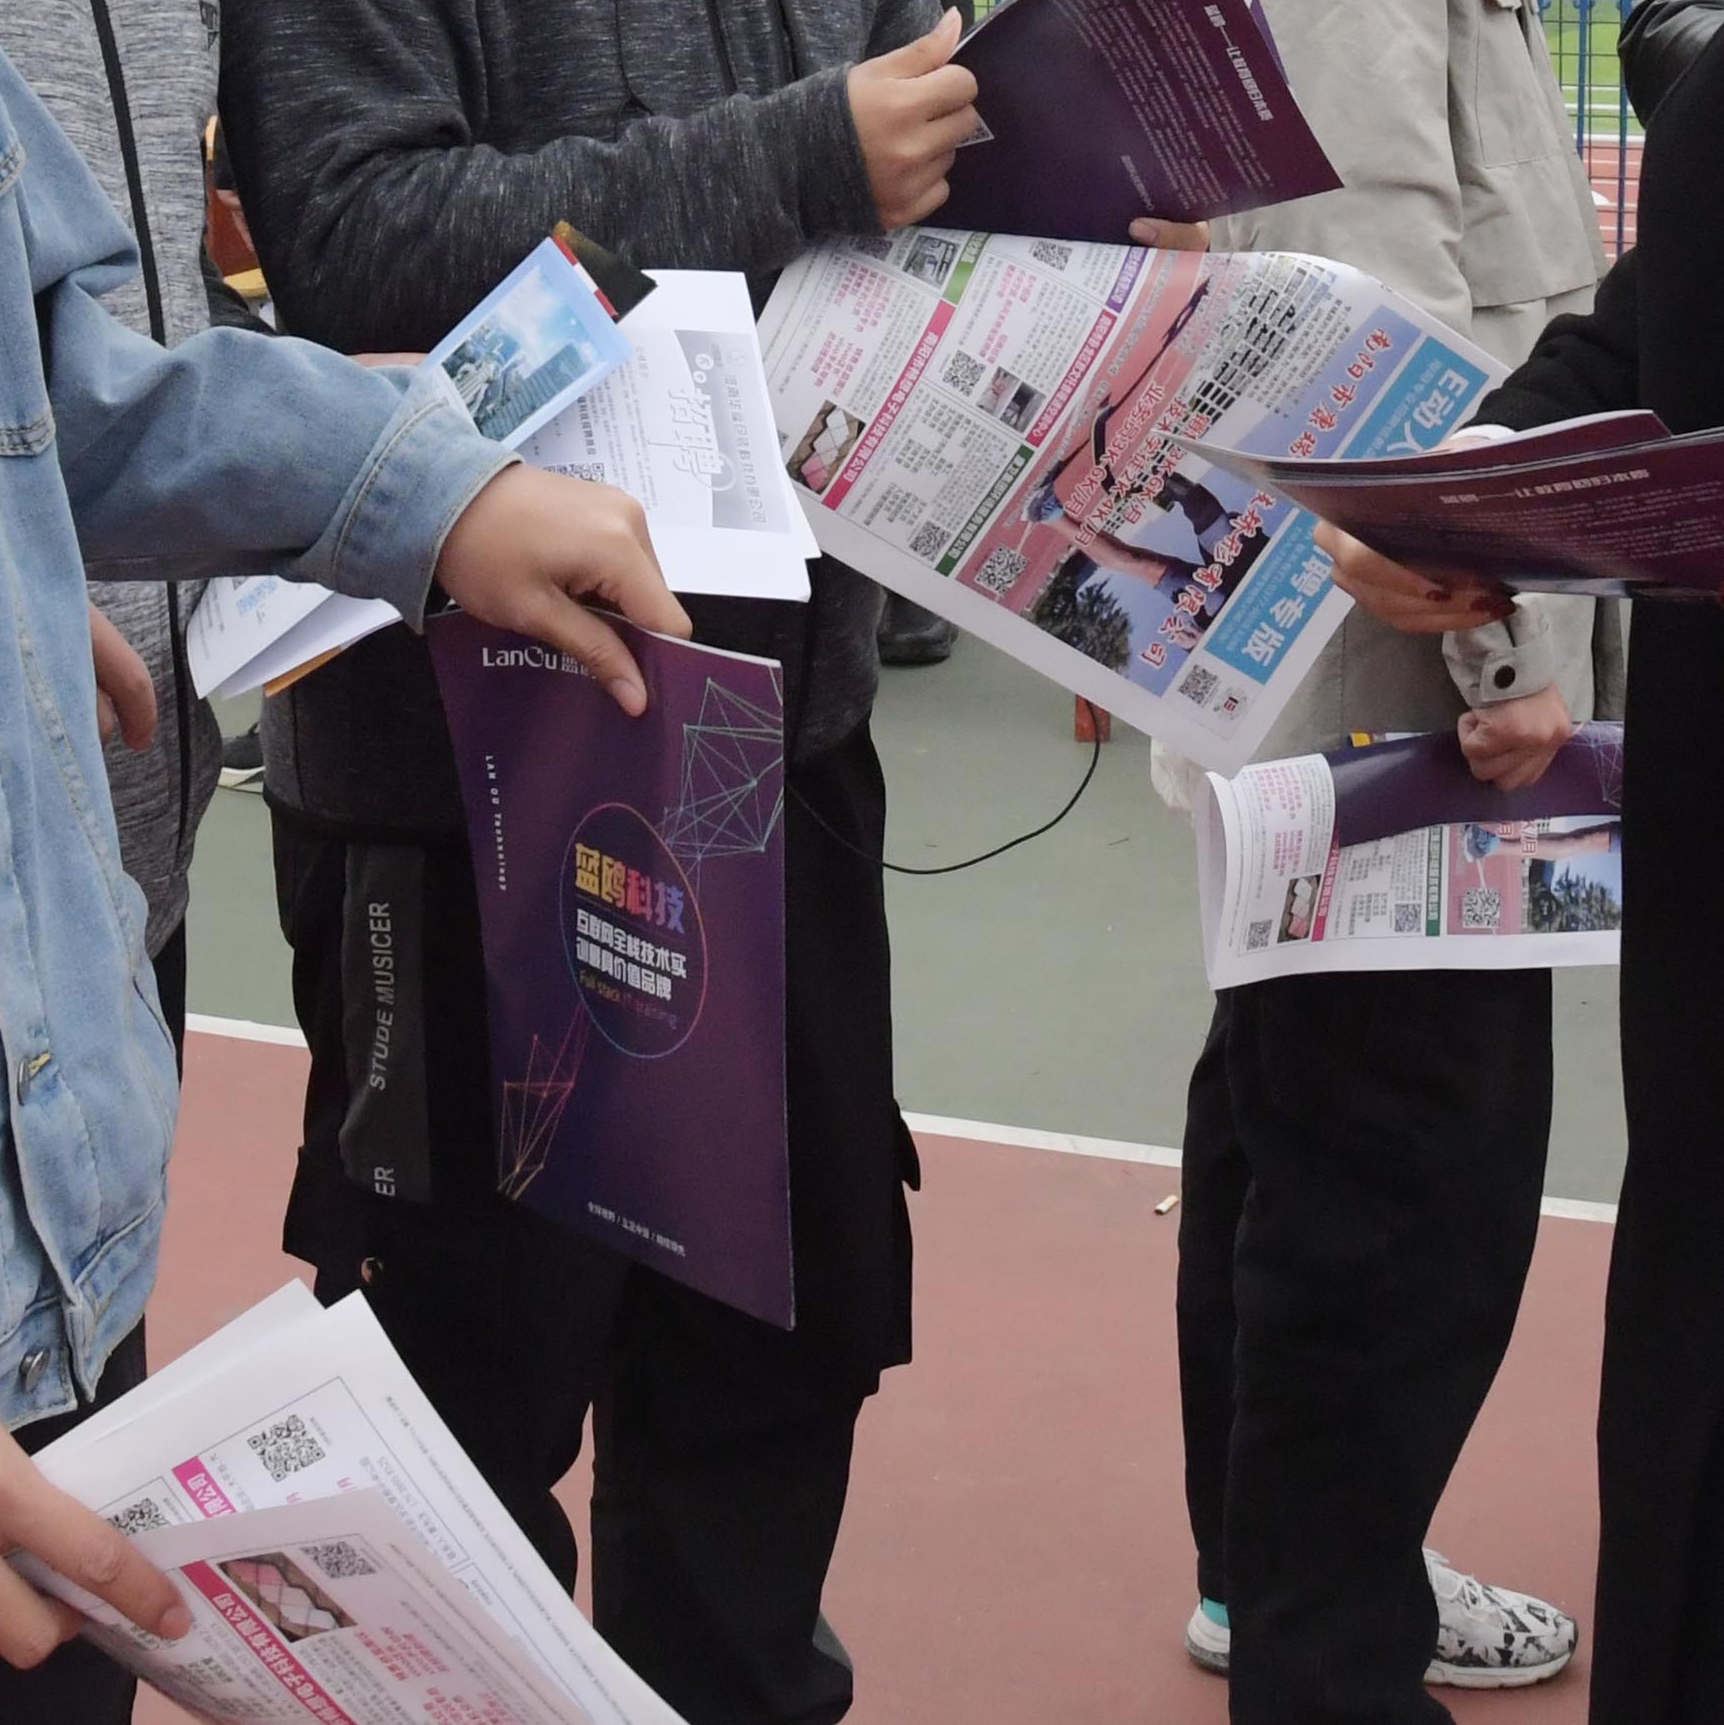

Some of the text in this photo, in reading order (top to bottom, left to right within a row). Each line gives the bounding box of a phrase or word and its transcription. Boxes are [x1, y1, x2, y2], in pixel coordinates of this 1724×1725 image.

[575, 843, 686, 936] 蓝鸥科技
[576, 908, 688, 979] 互联网全栈技术实
[576, 939, 673, 1002] 训最具价值品牌
[370, 901, 392, 1091] STUDE MUSICER
[371, 1165, 397, 1196] ER
